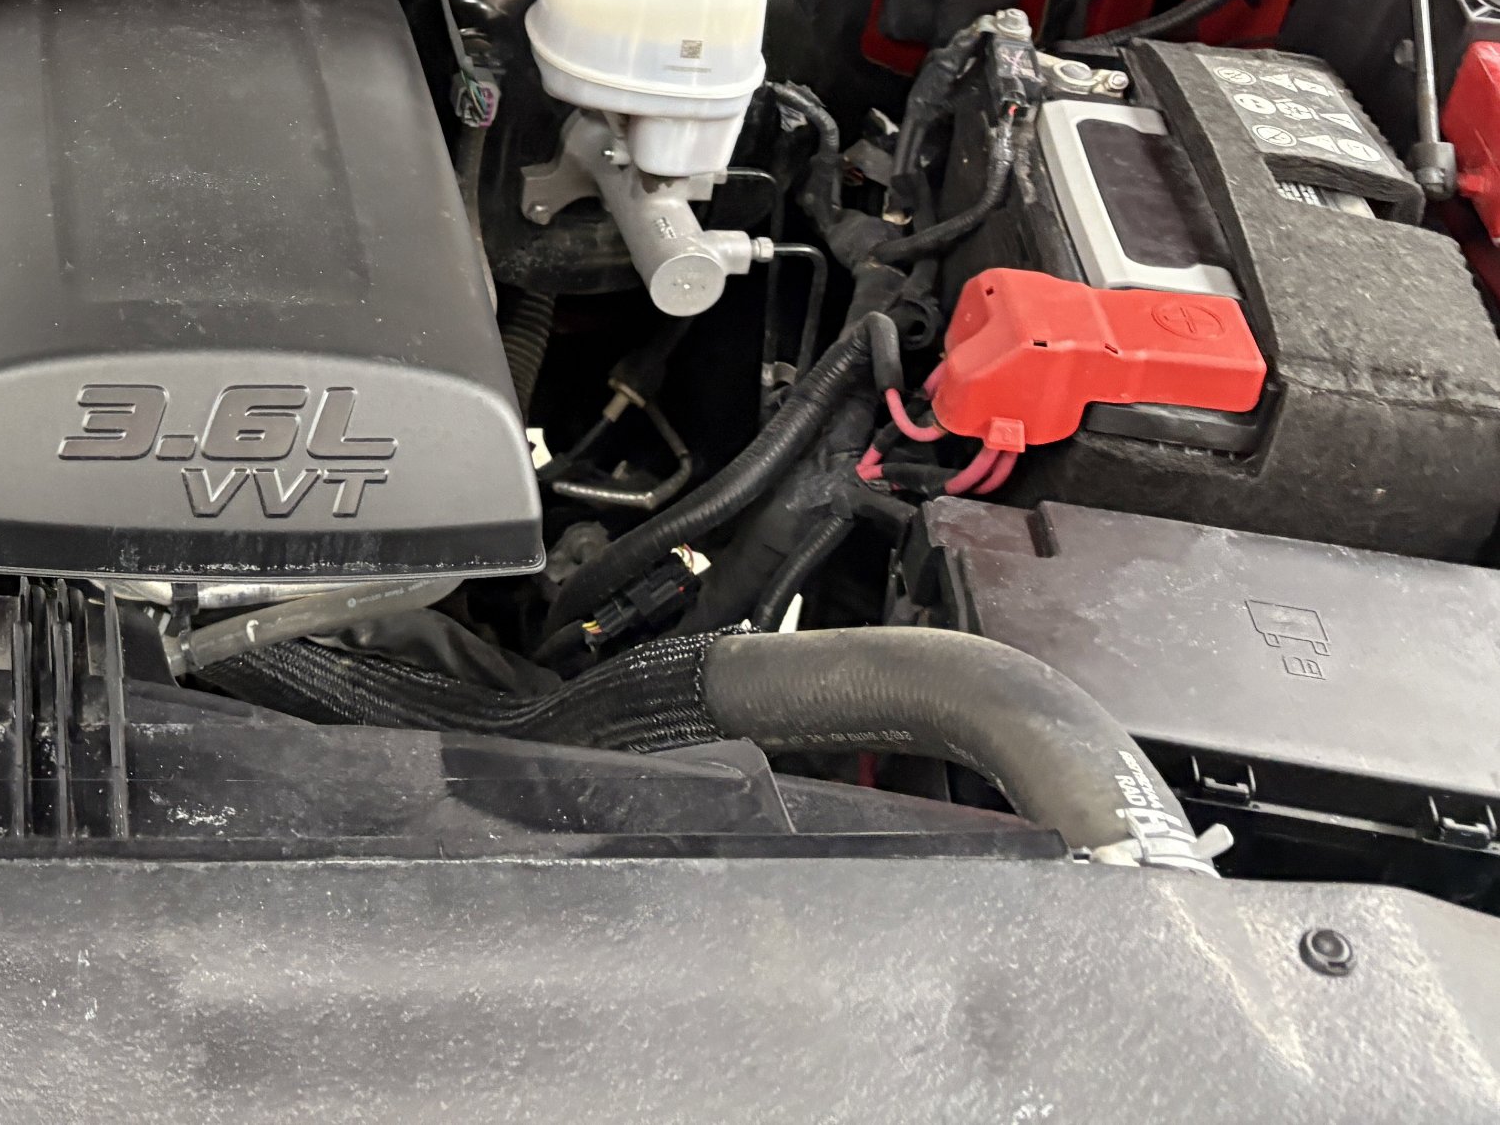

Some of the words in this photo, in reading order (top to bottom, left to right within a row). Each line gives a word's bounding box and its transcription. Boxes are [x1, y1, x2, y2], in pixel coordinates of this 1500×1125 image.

[57, 383, 399, 460] 3.6L
[181, 467, 389, 518] VVT
[1114, 774, 1148, 807] RAD
